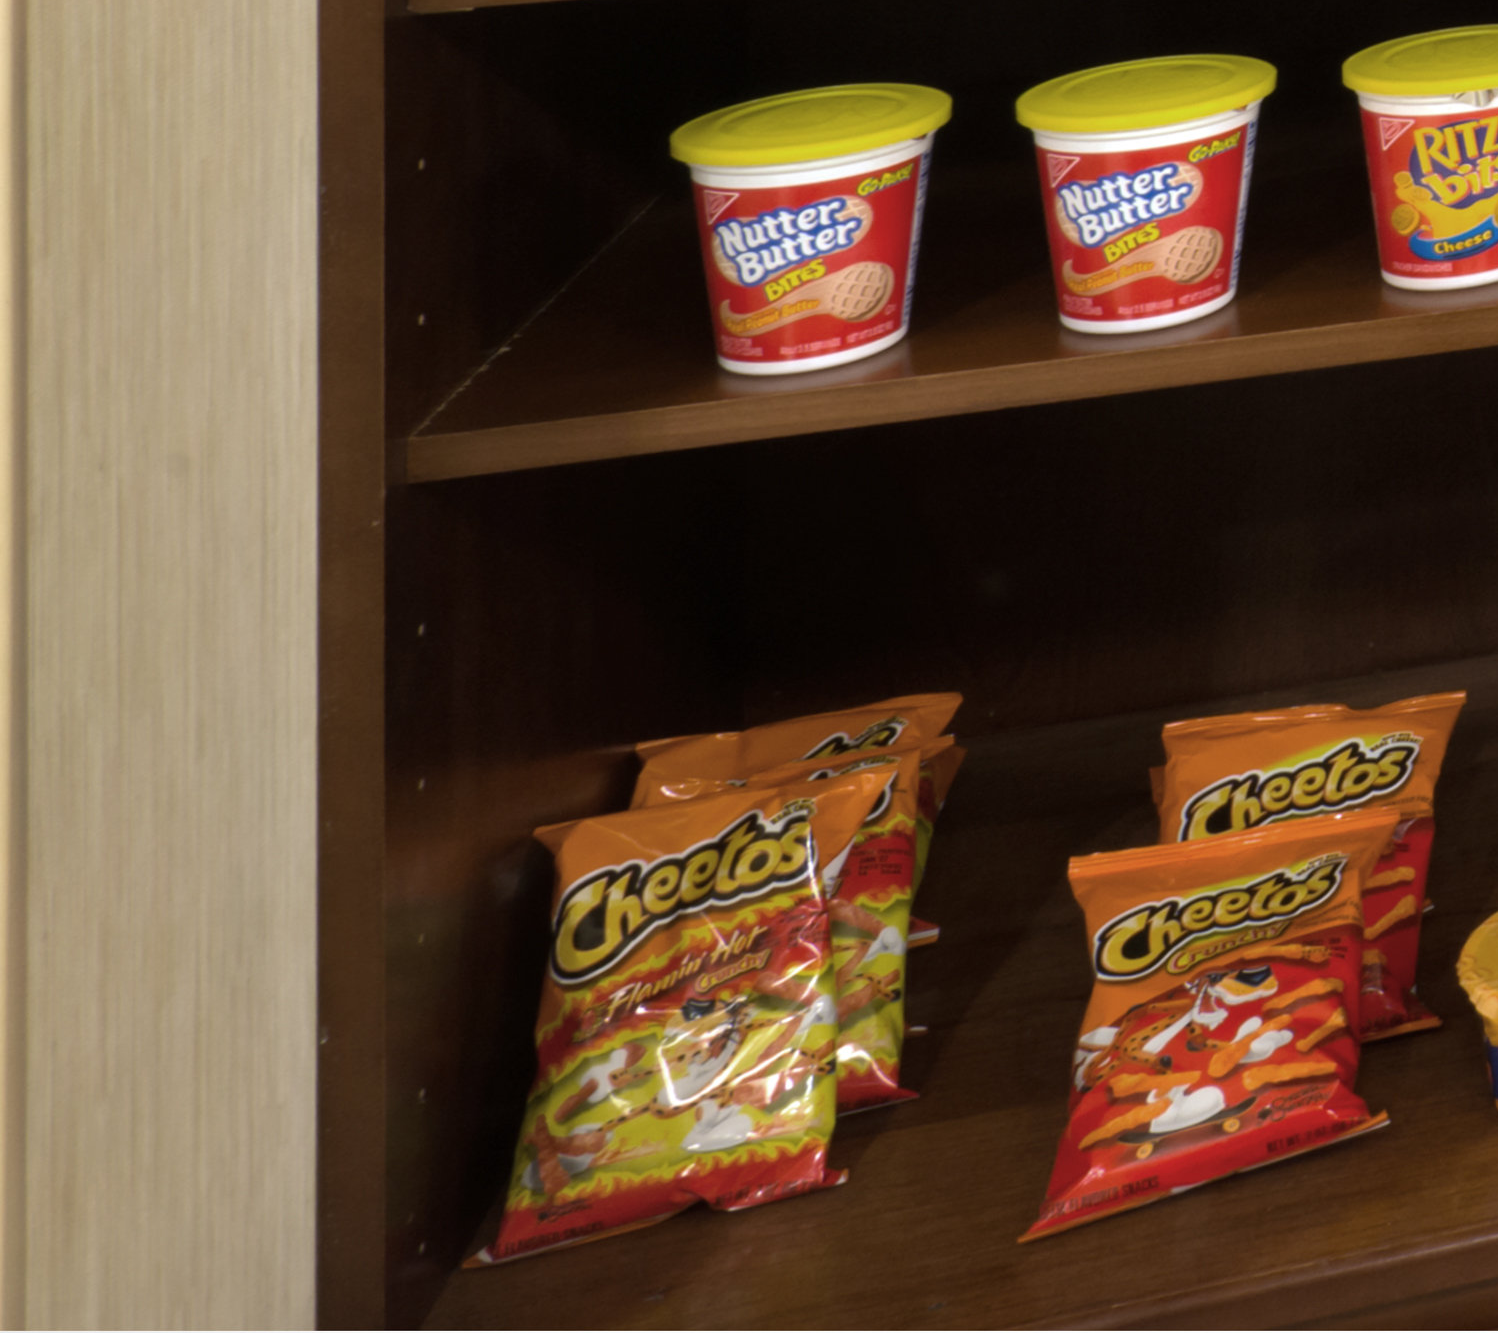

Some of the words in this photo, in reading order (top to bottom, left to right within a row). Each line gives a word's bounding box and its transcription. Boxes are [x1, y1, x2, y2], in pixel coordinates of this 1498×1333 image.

[716, 198, 845, 258] Nutter
[734, 217, 861, 284] Butter
[1433, 226, 1493, 256] Cheese
[765, 259, 827, 303] BITES
[554, 820, 811, 975] Cheetos
[1099, 861, 1343, 975] Cheetos
[695, 946, 771, 993] Crunchy
[709, 926, 769, 966] Hot
[1167, 920, 1289, 974] Crunchy
